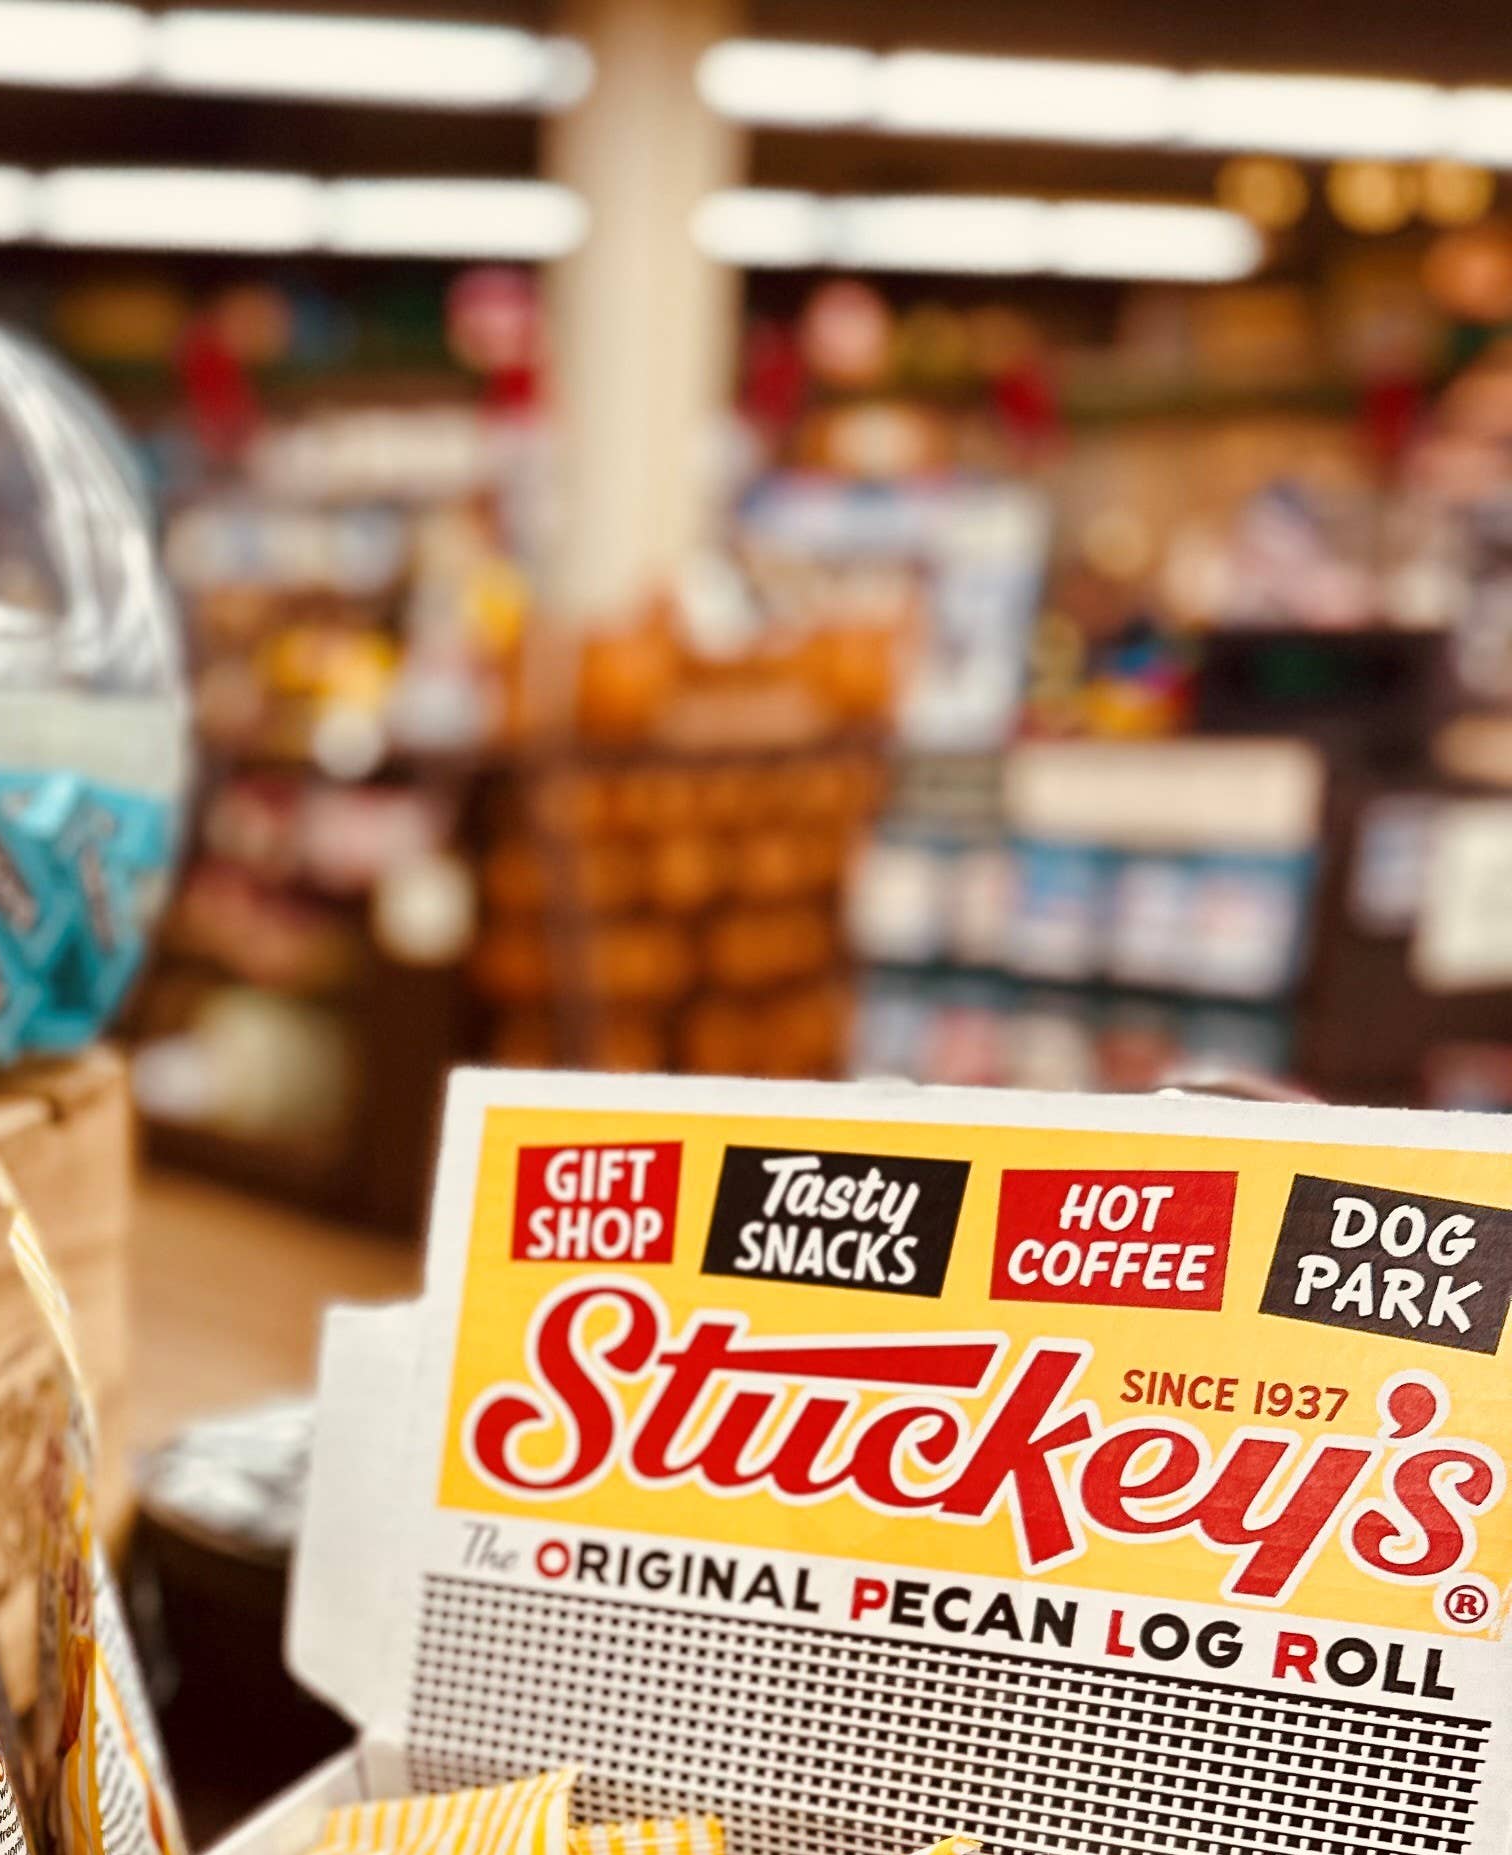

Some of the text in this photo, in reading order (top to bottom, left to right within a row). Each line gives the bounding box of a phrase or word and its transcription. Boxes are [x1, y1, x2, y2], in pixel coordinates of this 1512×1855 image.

[545, 1149, 655, 1203] GIFT
[762, 1156, 920, 1235] Tasty
[1059, 1184, 1175, 1233] HOT
[526, 1206, 664, 1260] SHOP
[734, 1221, 918, 1286] SNACKS
[1329, 1196, 1477, 1267] DOG
[1006, 1239, 1216, 1292] COFFEE
[1294, 1254, 1483, 1335] PARK
[1120, 1369, 1349, 1422] SINCE 1937
[474, 1287, 1493, 1598] Stuckey's
[462, 1522, 1456, 1701] The ORIGINAL PECAN LOG ROLL
